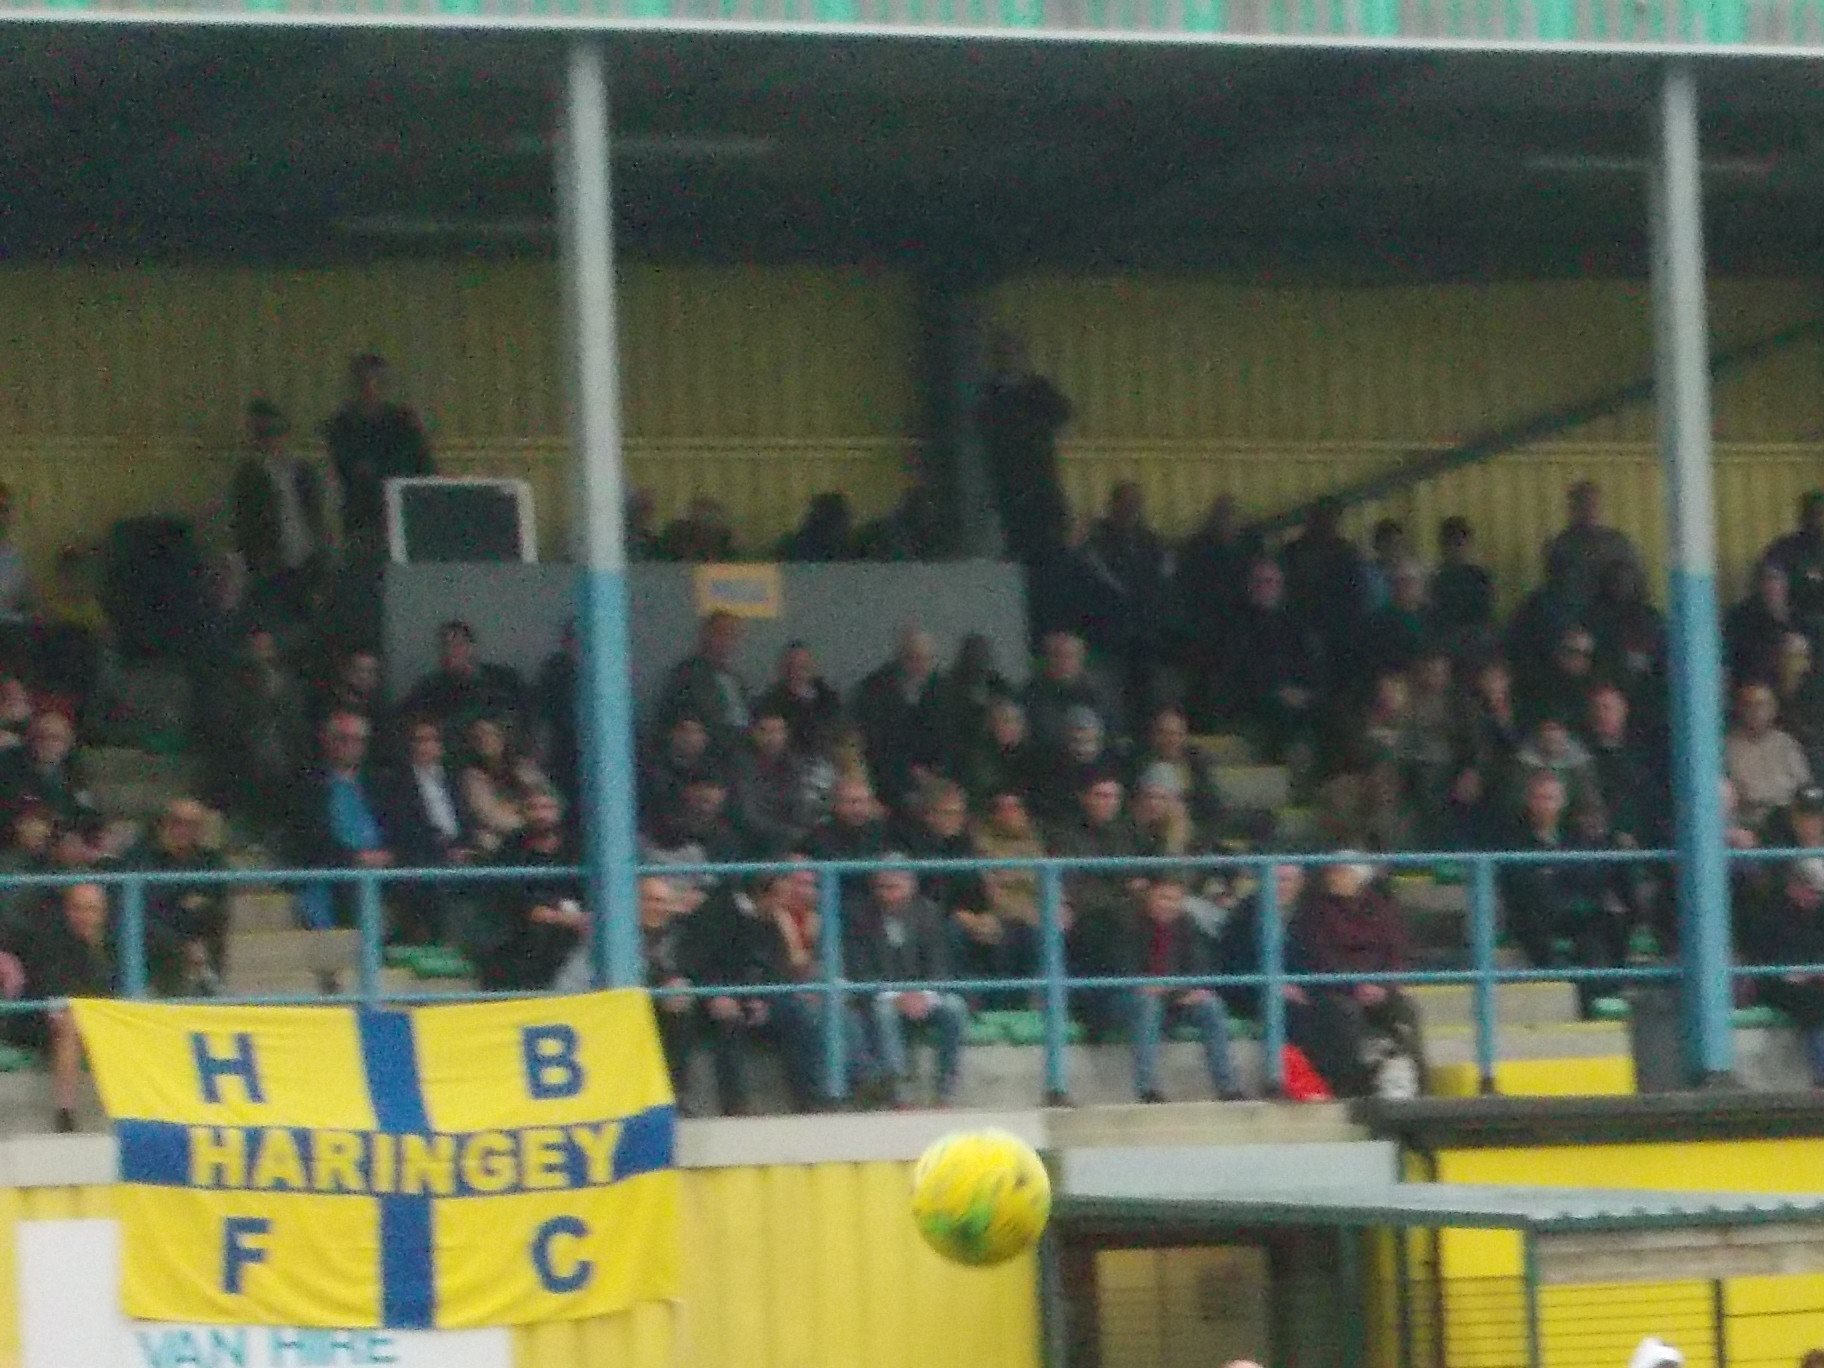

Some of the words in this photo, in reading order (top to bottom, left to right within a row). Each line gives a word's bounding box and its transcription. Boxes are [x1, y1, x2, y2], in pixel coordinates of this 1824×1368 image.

[189, 1031, 266, 1103] H
[521, 1024, 586, 1099] B
[190, 1120, 622, 1195] HARINGEY
[221, 1216, 272, 1294] F
[531, 1215, 593, 1293] C
[267, 1327, 398, 1367] HIRE
